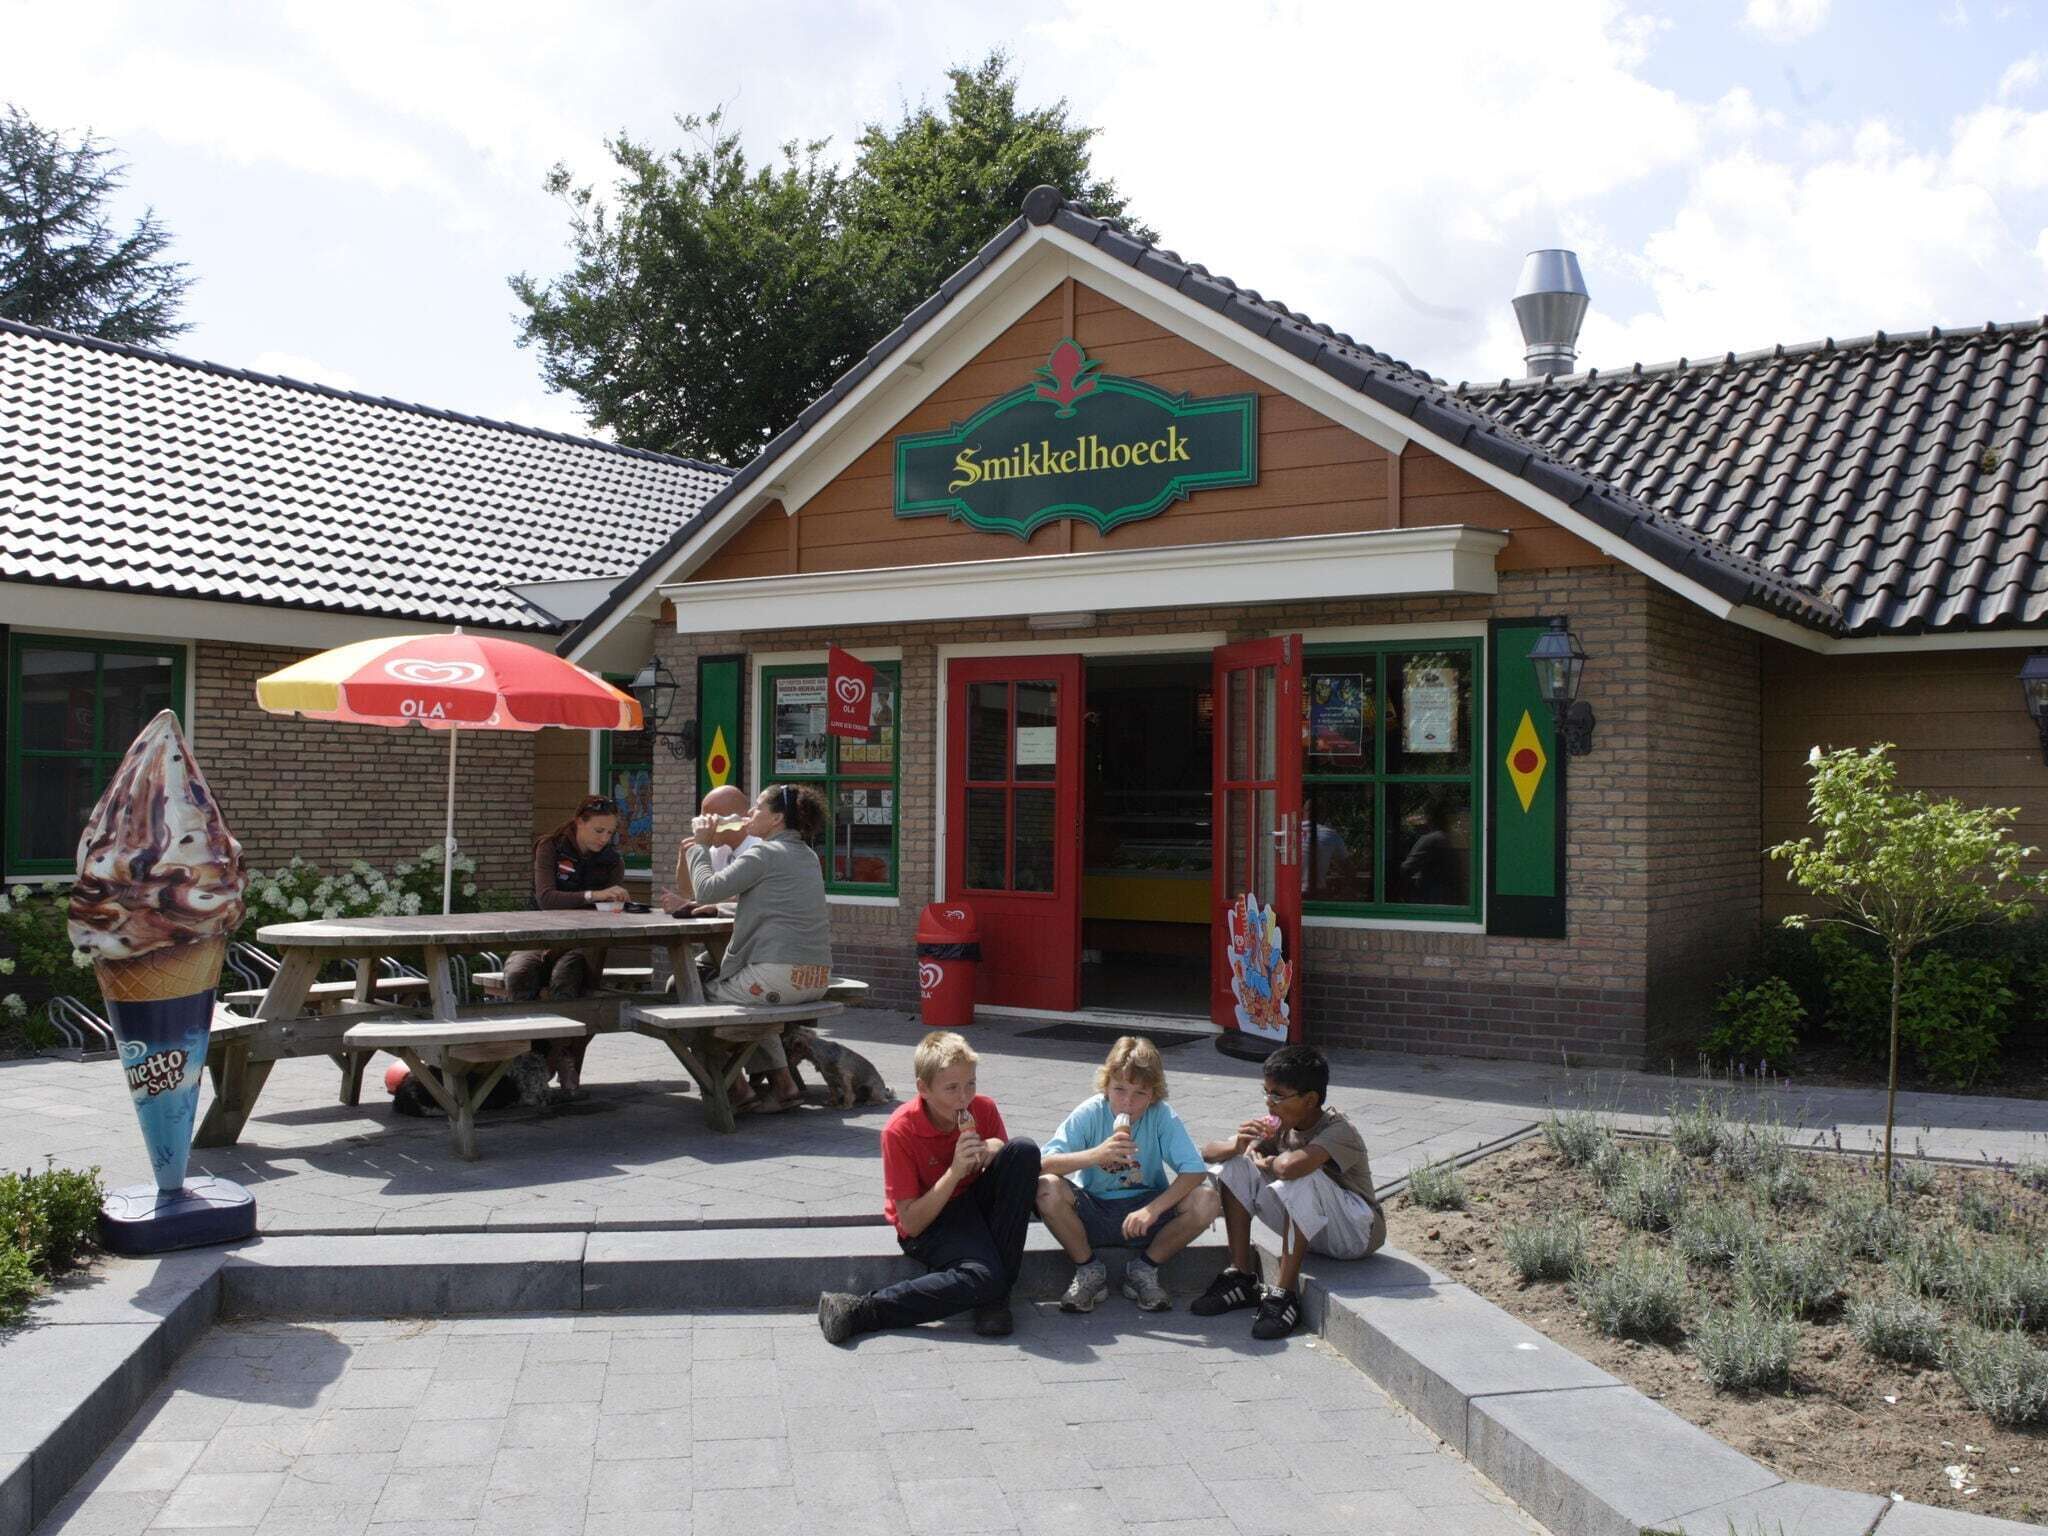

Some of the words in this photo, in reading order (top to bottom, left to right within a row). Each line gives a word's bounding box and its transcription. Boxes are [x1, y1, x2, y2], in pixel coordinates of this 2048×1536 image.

[948, 426, 1190, 493] Smikkelhoeck
[400, 699, 446, 719] OLA
[843, 705, 855, 713] OLA
[127, 1051, 182, 1085] netto
[148, 1071, 184, 1094] Soft
